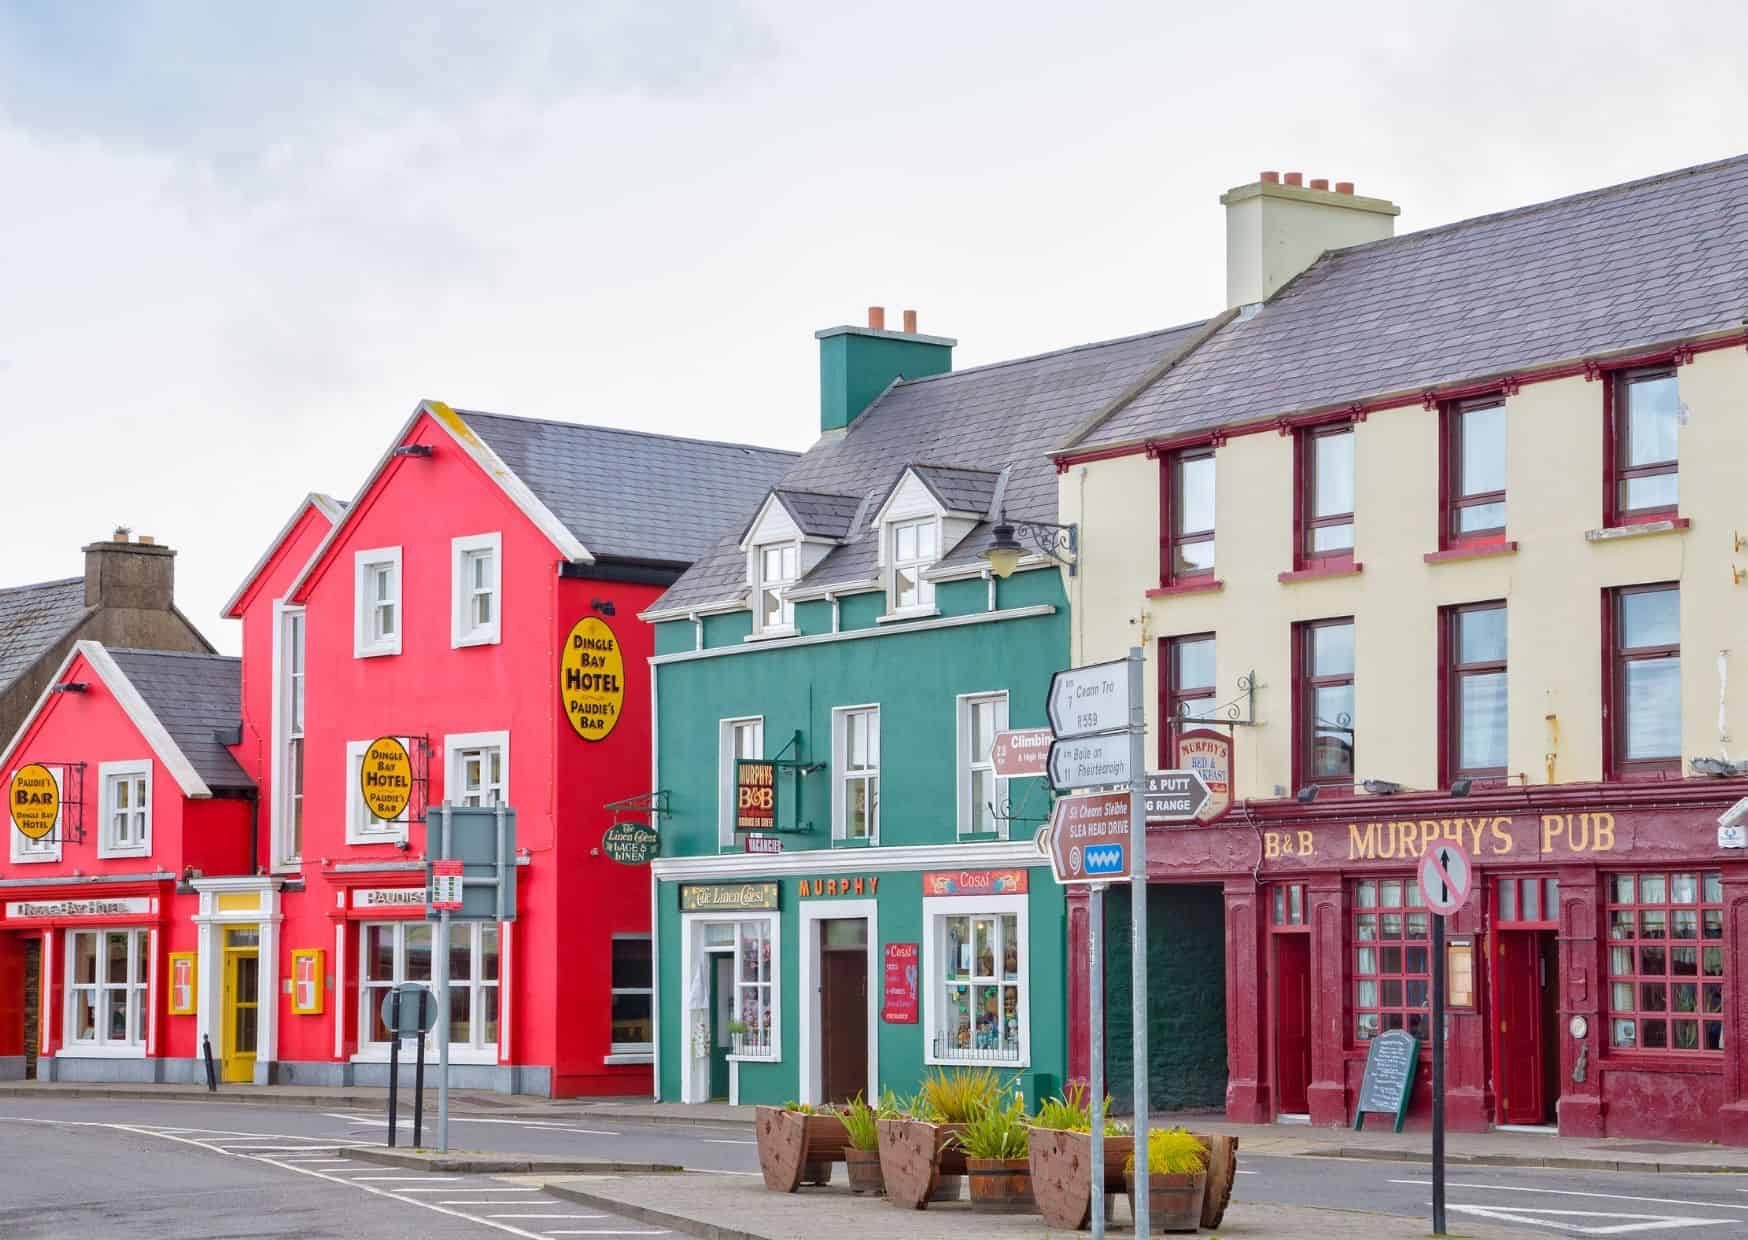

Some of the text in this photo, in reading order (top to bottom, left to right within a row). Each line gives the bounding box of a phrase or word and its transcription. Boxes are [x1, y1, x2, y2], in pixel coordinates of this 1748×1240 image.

[574, 634, 613, 651] DINGLE
[581, 652, 605, 667] BAY
[567, 667, 620, 692] HOTEL
[571, 700, 615, 715] PAUDIE'S
[581, 717, 604, 729] BAR
[1077, 712, 1098, 728] R559
[1011, 734, 1054, 749] Climbin
[1181, 740, 1226, 758] MURPHY'S
[371, 750, 402, 761] DINGLE
[377, 761, 396, 772] BAY
[367, 772, 408, 788] HOTEL
[739, 764, 773, 785] MURPHYS
[1149, 779, 1190, 791] & PUTT
[16, 790, 53, 805] BAR
[739, 786, 773, 808] B&B
[377, 803, 396, 813] BAR
[1156, 799, 1190, 811] RANGE
[23, 820, 48, 829] HOTEL
[1070, 819, 1128, 837] SLEA HEAD DRIVE
[1349, 812, 1616, 860] MURPHY'S PUB
[799, 876, 879, 897] MURPHY
[713, 887, 740, 905] Linen
